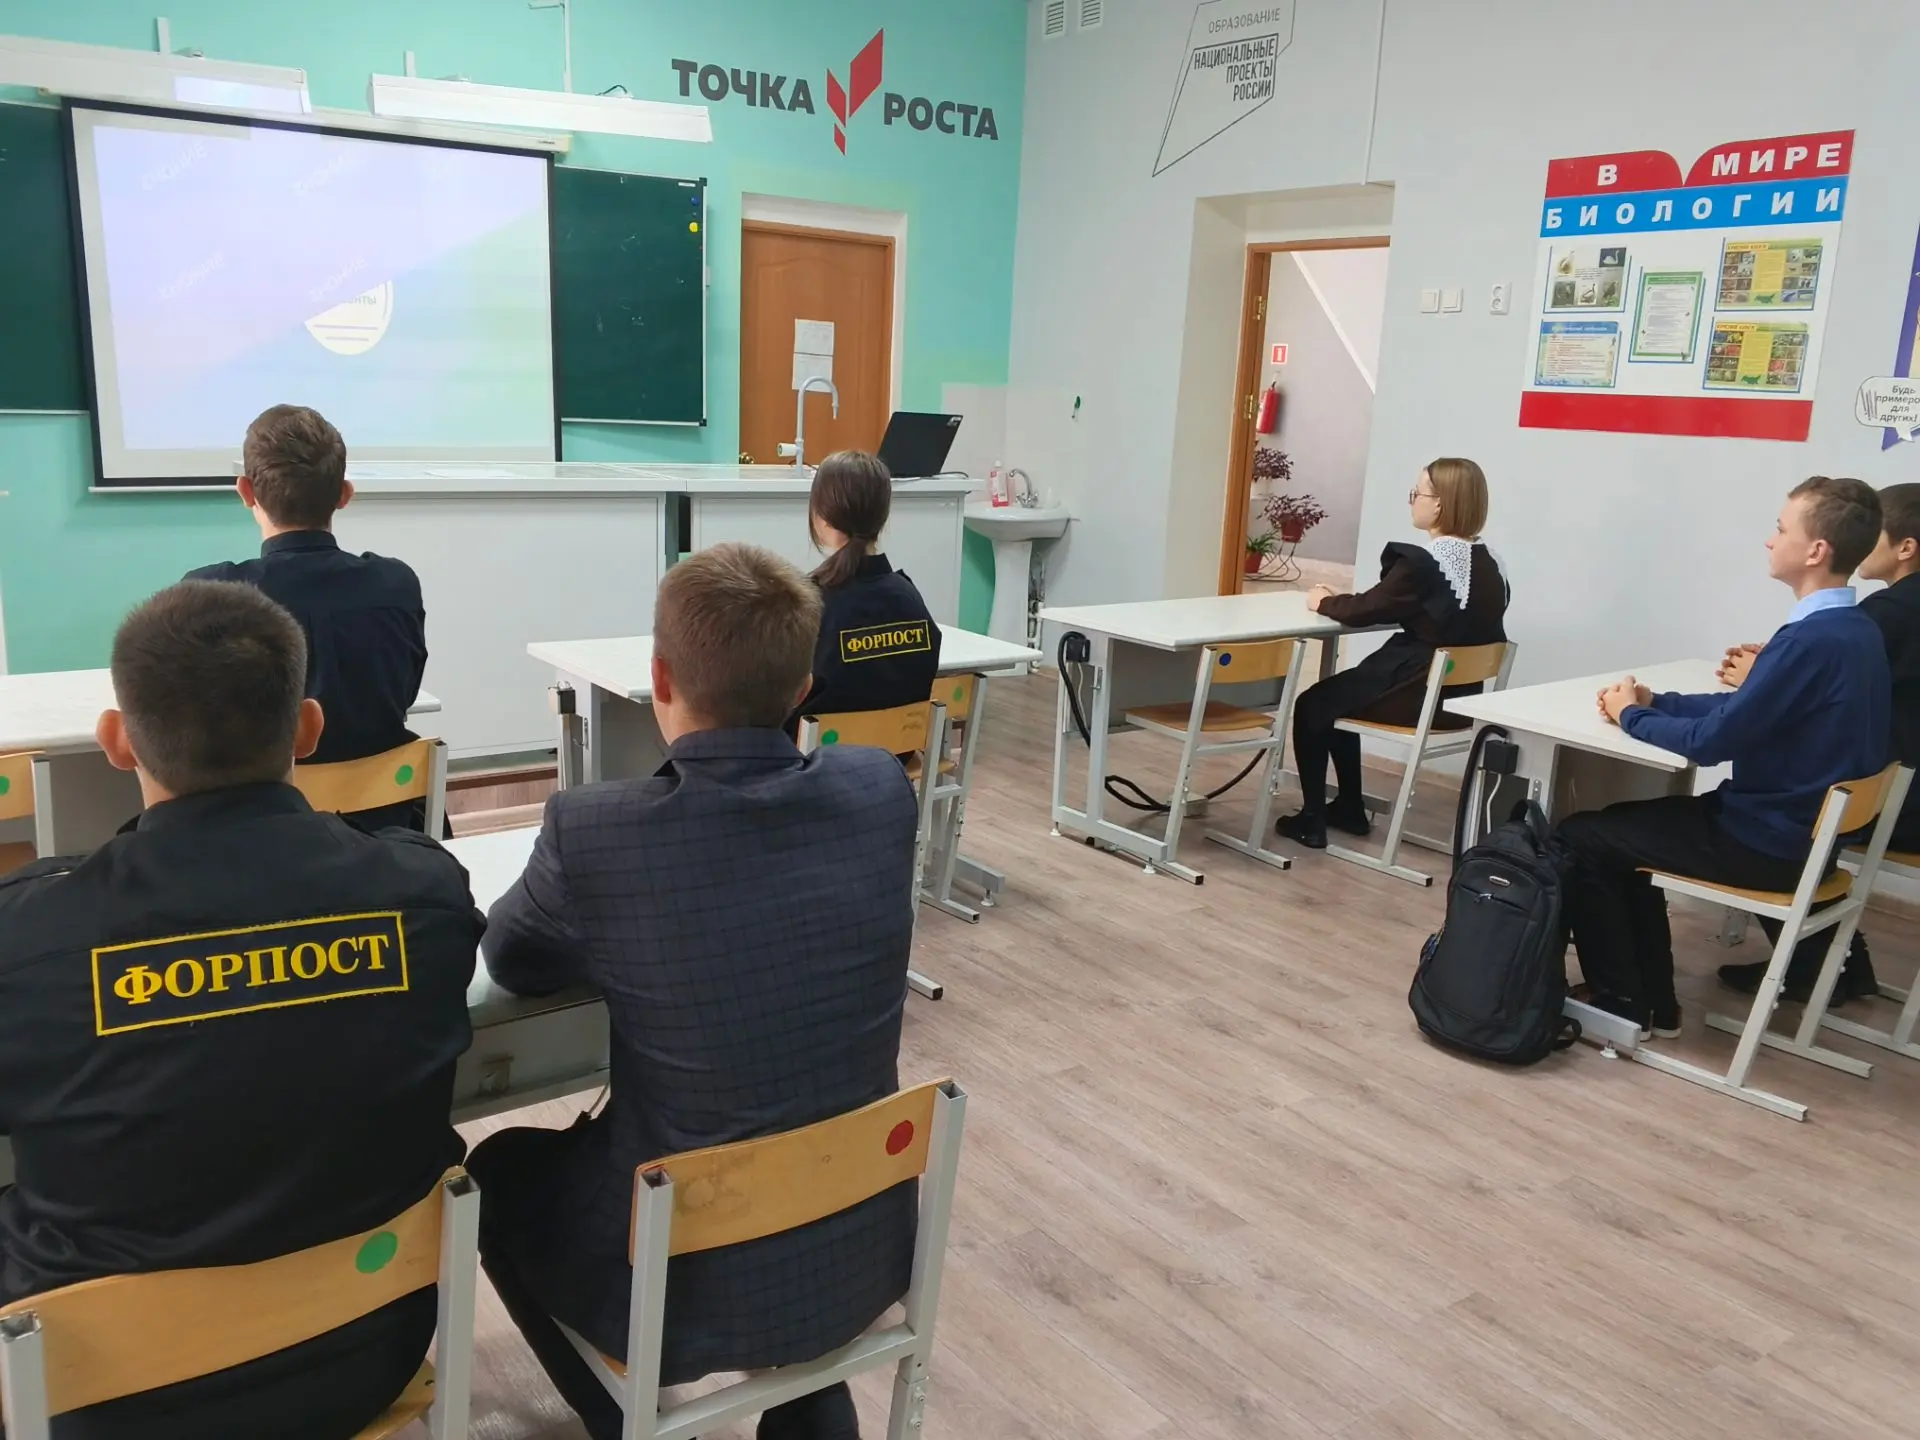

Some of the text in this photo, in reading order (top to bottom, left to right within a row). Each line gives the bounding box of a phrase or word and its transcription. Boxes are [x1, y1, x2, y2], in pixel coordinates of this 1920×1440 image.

[1208, 8, 1281, 33] ОБРАЗОВАНИЕ
[1194, 38, 1275, 70] НАЦИОНАЛЬНЫЕ
[1226, 58, 1273, 83] ПРОЕКТЫ
[671, 58, 999, 140] ТОЧКА РОСТА
[1233, 80, 1272, 101] РОССИИ
[1597, 142, 1842, 186] В МИРЕ
[1546, 187, 1840, 229] БИОЛОГИИ
[1890, 405, 1910, 413] для
[846, 628, 924, 653] ФОРПОСТ
[114, 934, 390, 1005] ФОРПОСТ
